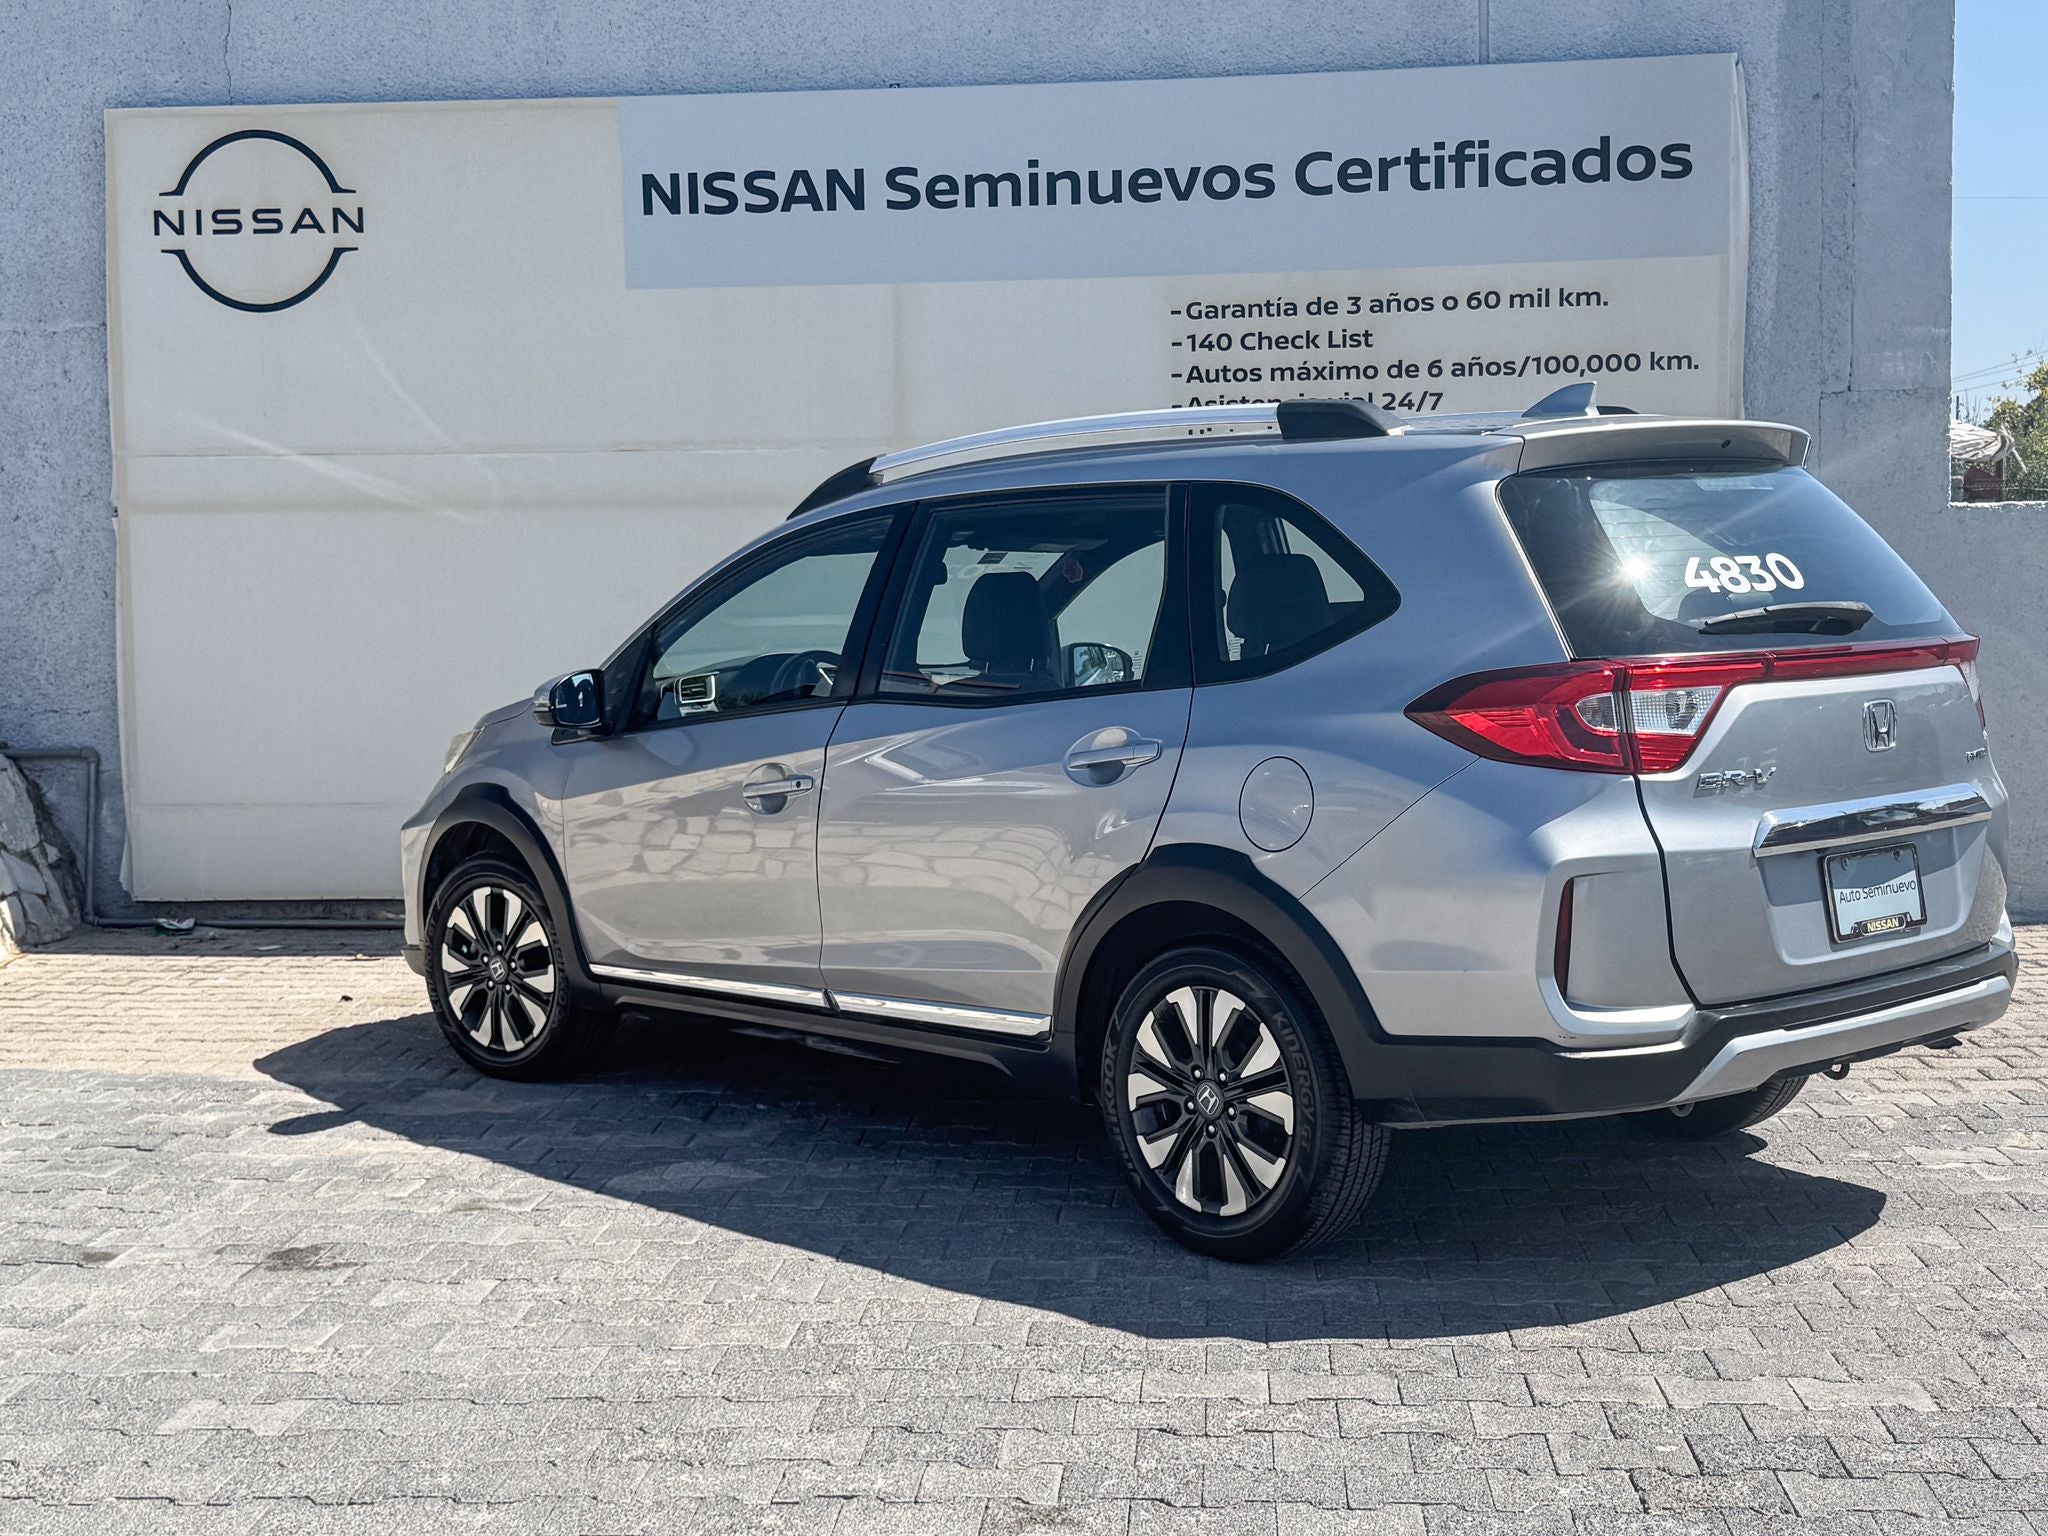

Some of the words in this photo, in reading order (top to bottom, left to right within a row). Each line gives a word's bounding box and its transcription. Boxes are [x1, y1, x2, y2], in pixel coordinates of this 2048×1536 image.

[641, 168, 866, 216] NISSAN
[886, 159, 1276, 211] Seminuevos
[1295, 135, 1693, 197] Certificados
[153, 206, 365, 237] NISSAN
[1170, 297, 1298, 321] -Garantía
[1306, 296, 1339, 316] de
[1346, 296, 1362, 315] 3
[1368, 292, 1435, 314] años
[1441, 295, 1459, 311] o
[1466, 290, 1501, 311] 60
[1509, 287, 1550, 309] mil
[1558, 287, 1609, 308] km.
[1171, 332, 1233, 353] -140
[1239, 329, 1321, 351] Check
[1327, 328, 1374, 349] List
[1171, 364, 1263, 384] -Autos
[1270, 360, 1379, 382] máximo
[1386, 359, 1420, 379] de
[1427, 359, 1444, 378] 6
[1450, 352, 1642, 378] años/100,000
[1649, 351, 1700, 372] km.
[1381, 391, 1444, 413] 24/7
[1683, 552, 1805, 594] 4830
[1840, 890, 1861, 904] Auto
[1862, 880, 1916, 899] Seminuevo
[1866, 917, 1899, 932] NISSAN
